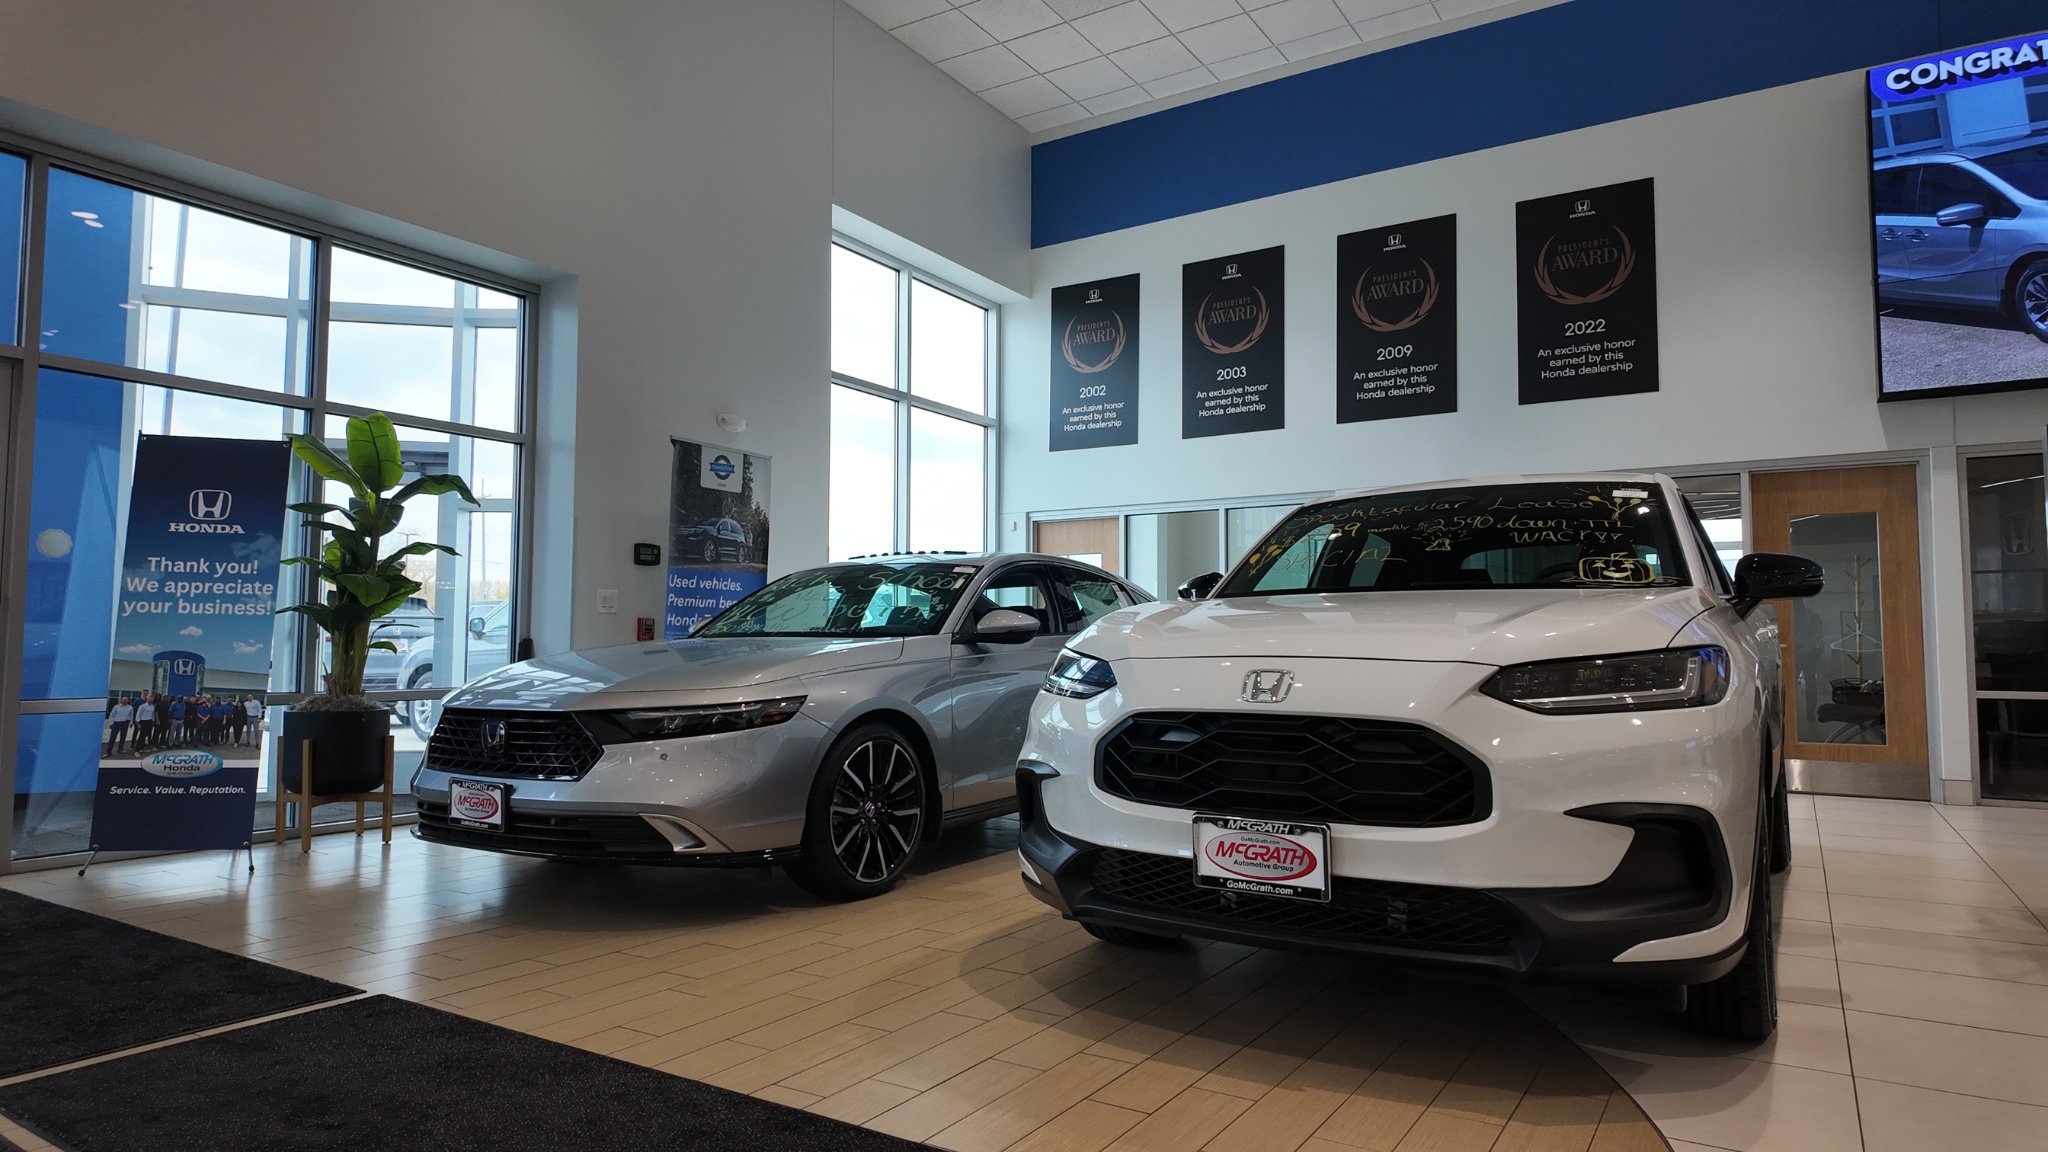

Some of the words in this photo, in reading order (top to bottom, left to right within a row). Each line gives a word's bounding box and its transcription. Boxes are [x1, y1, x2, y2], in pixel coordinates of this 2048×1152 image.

[1569, 210, 1596, 218] HONDA
[1552, 248, 1618, 272] AWARD
[1368, 279, 1424, 300] AWARD
[1208, 305, 1257, 325] AWARD
[1564, 318, 1606, 336] 2022
[1073, 328, 1116, 346] AWARD
[1377, 345, 1413, 360] 2009
[1538, 348, 1552, 358] An
[1555, 343, 1601, 356] exclusive
[1604, 339, 1636, 349] honor
[1550, 355, 1585, 367] earned
[1589, 354, 1601, 364] by
[1605, 351, 1623, 360] this
[1217, 366, 1247, 380] 2003
[1354, 371, 1366, 380] An
[1368, 367, 1408, 378] exclusive
[1411, 363, 1438, 372] honor
[1541, 367, 1575, 379] Honda
[1578, 361, 1633, 374] dealership
[1364, 378, 1395, 389] earned
[1397, 377, 1408, 386] by
[1411, 374, 1427, 383] this
[1080, 385, 1106, 398] 2002
[1197, 390, 1207, 398] An
[1209, 387, 1242, 397] exclusive
[1245, 383, 1268, 392] honor
[1357, 390, 1385, 400] Honda
[1388, 384, 1435, 396] dealership
[1062, 407, 1071, 415] An
[1073, 404, 1102, 413] exclusive
[1104, 401, 1124, 409] honor
[1205, 396, 1231, 407] earned
[1233, 396, 1243, 405] by
[1245, 394, 1259, 402] this
[1070, 413, 1092, 422] earned
[1094, 412, 1102, 421] by
[1199, 408, 1224, 417] Honda
[1226, 404, 1266, 415] dealership
[1064, 422, 1086, 432] Honda
[1087, 420, 1122, 430] dealership
[168, 523, 245, 534] HONDA
[148, 556, 210, 573] Thank
[215, 560, 258, 577] you!
[126, 576, 159, 592] We
[164, 580, 274, 597] appreciate
[669, 574, 697, 589] Used
[700, 577, 742, 591] vehicles.
[122, 601, 172, 616] your
[178, 599, 271, 615] business!
[668, 594, 716, 608] Premium
[164, 764, 200, 772] Honda
[110, 786, 151, 794] Service.
[155, 786, 186, 794] Value.
[190, 786, 246, 796] Reputation.
[1227, 820, 1290, 834] McGRATH
[1240, 836, 1280, 845] GoMcGrath.com
[1216, 841, 1307, 866] McGRATH
[1233, 859, 1272, 869] Automotive
[1273, 864, 1294, 872] Group
[1227, 880, 1294, 895] GoMcGrath.com
